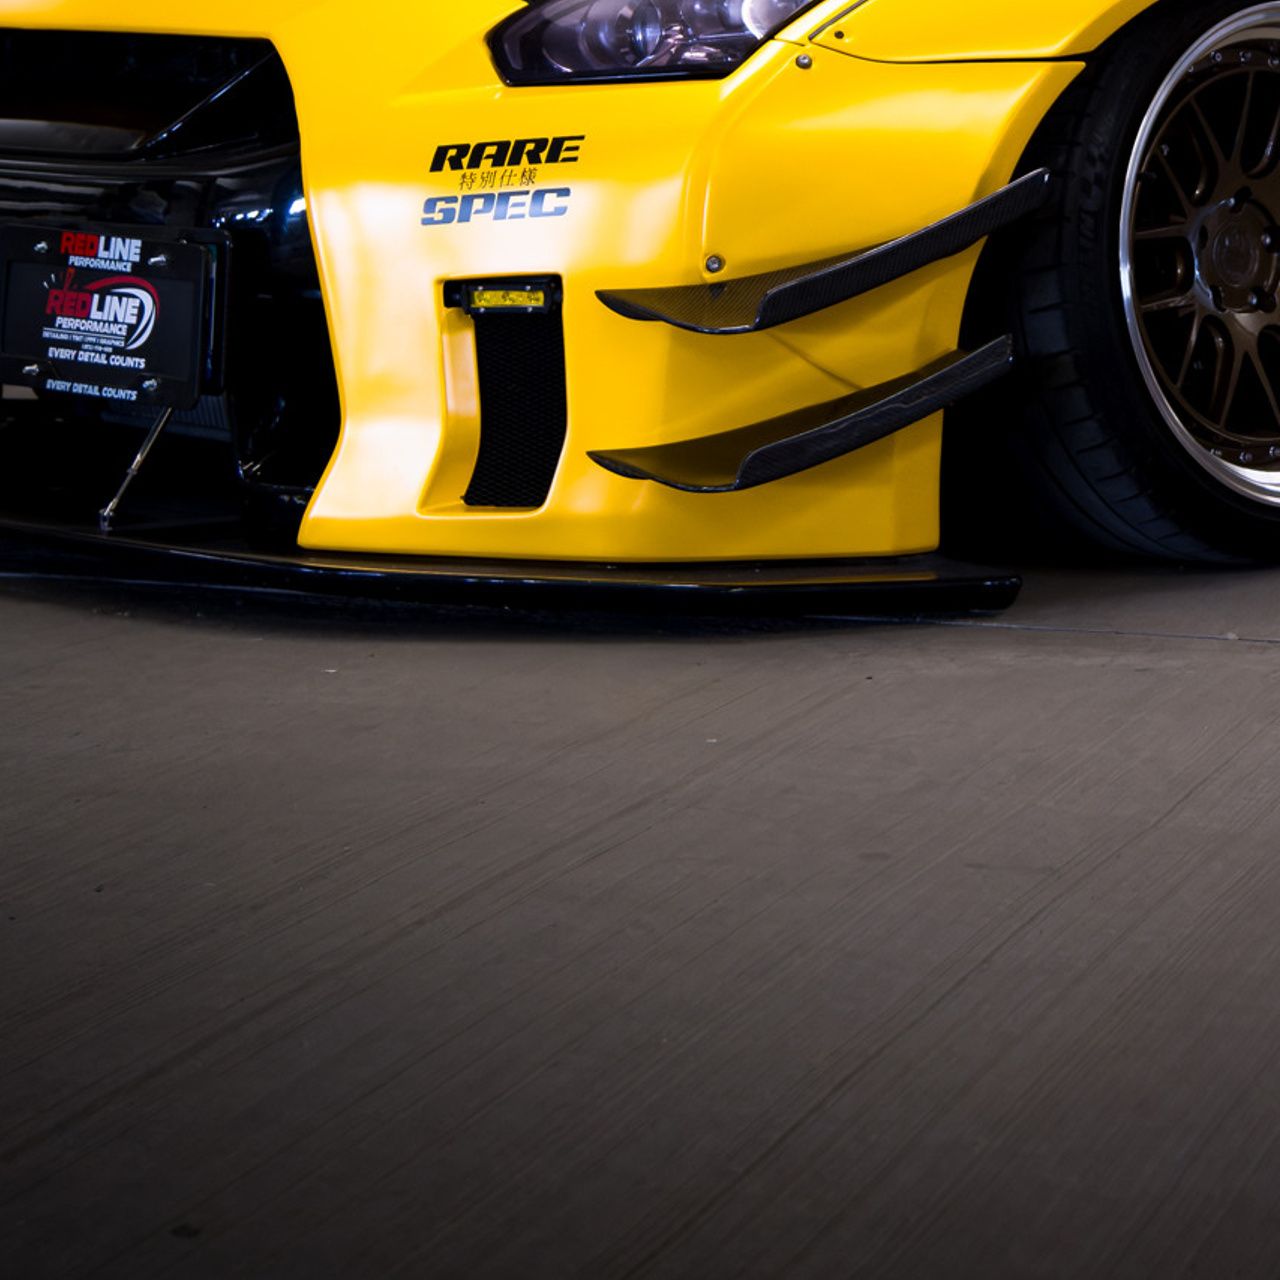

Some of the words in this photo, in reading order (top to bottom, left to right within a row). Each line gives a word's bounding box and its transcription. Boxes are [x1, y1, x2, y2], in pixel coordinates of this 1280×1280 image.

[428, 134, 586, 173] RARE
[420, 186, 571, 226] SPEC
[60, 231, 142, 262] REDLINE
[68, 255, 133, 272] PERFORMANCE
[45, 288, 141, 324] REDLINE
[55, 316, 128, 336] PERFORMANCE
[48, 347, 77, 360] EVERY
[77, 351, 108, 364] DETAIL
[109, 355, 146, 369] COUNTS
[46, 379, 72, 392] EVERY
[72, 382, 101, 396] DETAIL
[101, 387, 138, 401] COUNTS
